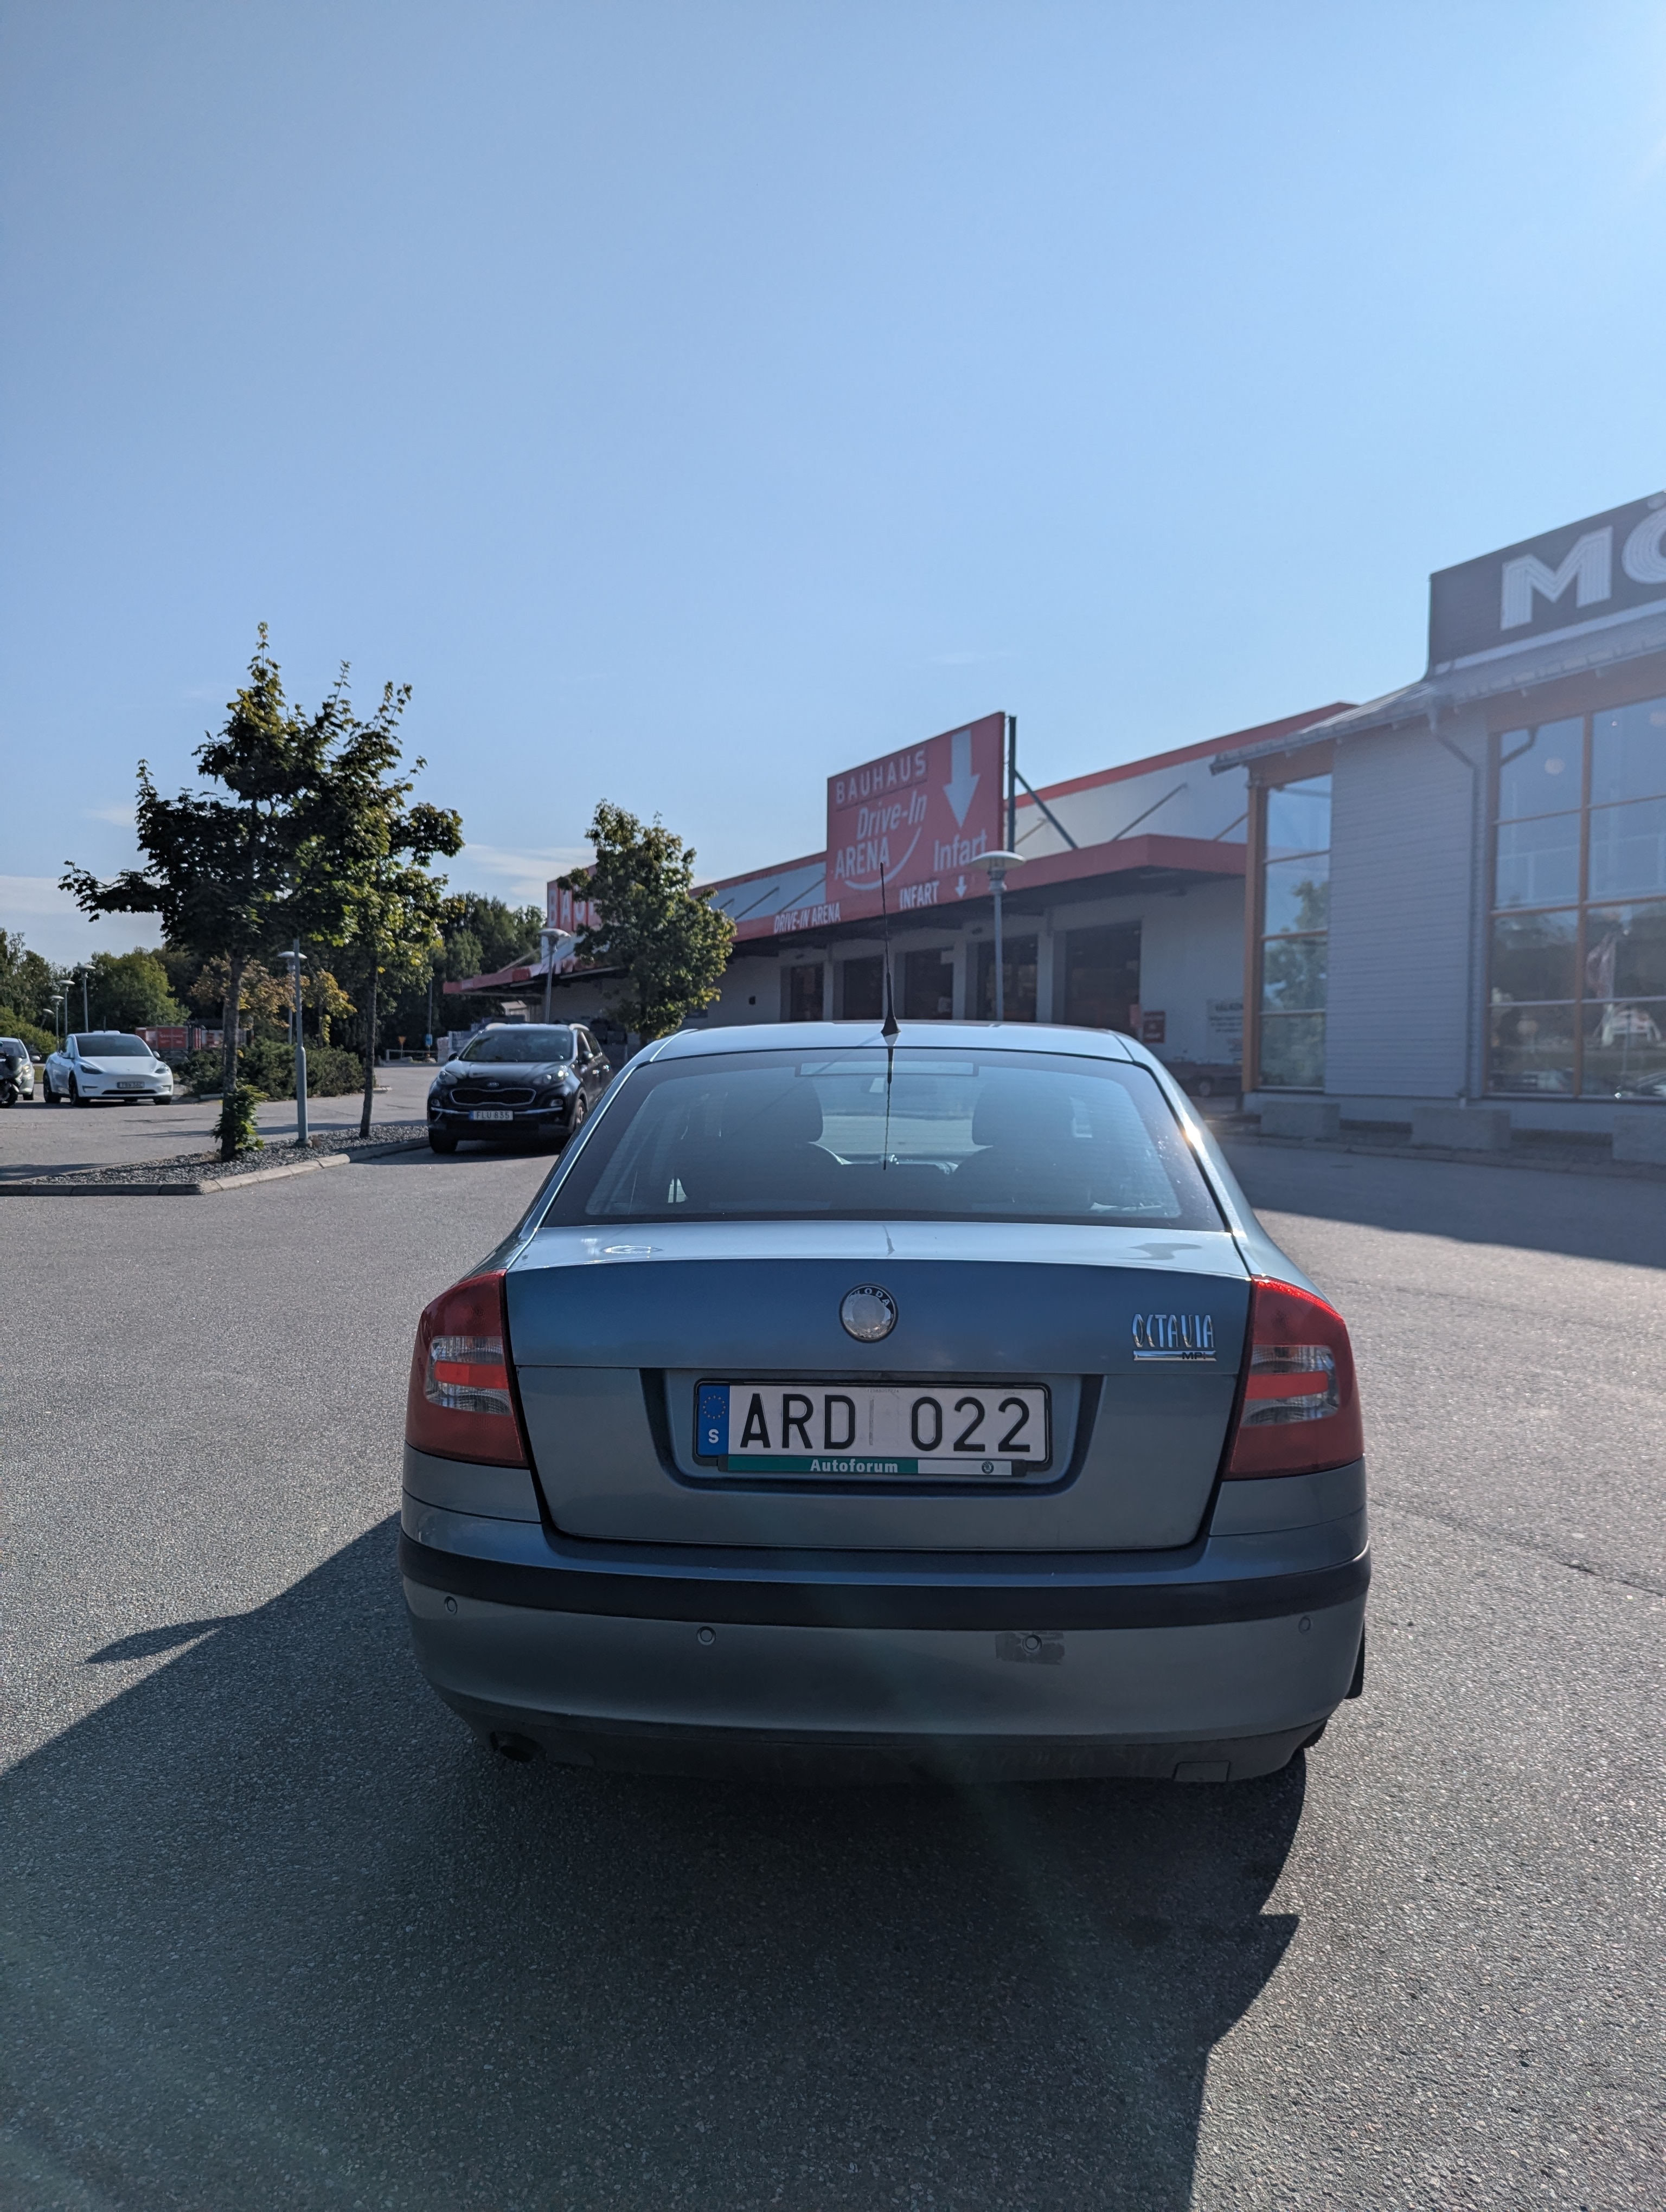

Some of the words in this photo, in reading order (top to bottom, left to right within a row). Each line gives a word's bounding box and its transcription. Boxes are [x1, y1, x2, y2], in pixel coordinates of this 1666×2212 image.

[836, 750, 926, 804] BAUHAUS
[856, 789, 927, 840] Drive-In
[834, 837, 890, 880] ARENA
[933, 828, 987, 872] Infart
[899, 880, 939, 910] INFART
[774, 909, 810, 934] DRIVE-IN
[811, 902, 841, 927] ARENA
[476, 1111, 492, 1119] FLU
[494, 1111, 510, 1119] 835
[1132, 1314, 1215, 1348] OCTAVIA
[708, 1429, 719, 1443] S
[740, 1393, 856, 1450] ARD
[911, 1396, 1030, 1452] 022
[810, 1458, 898, 1473] Autoforum
